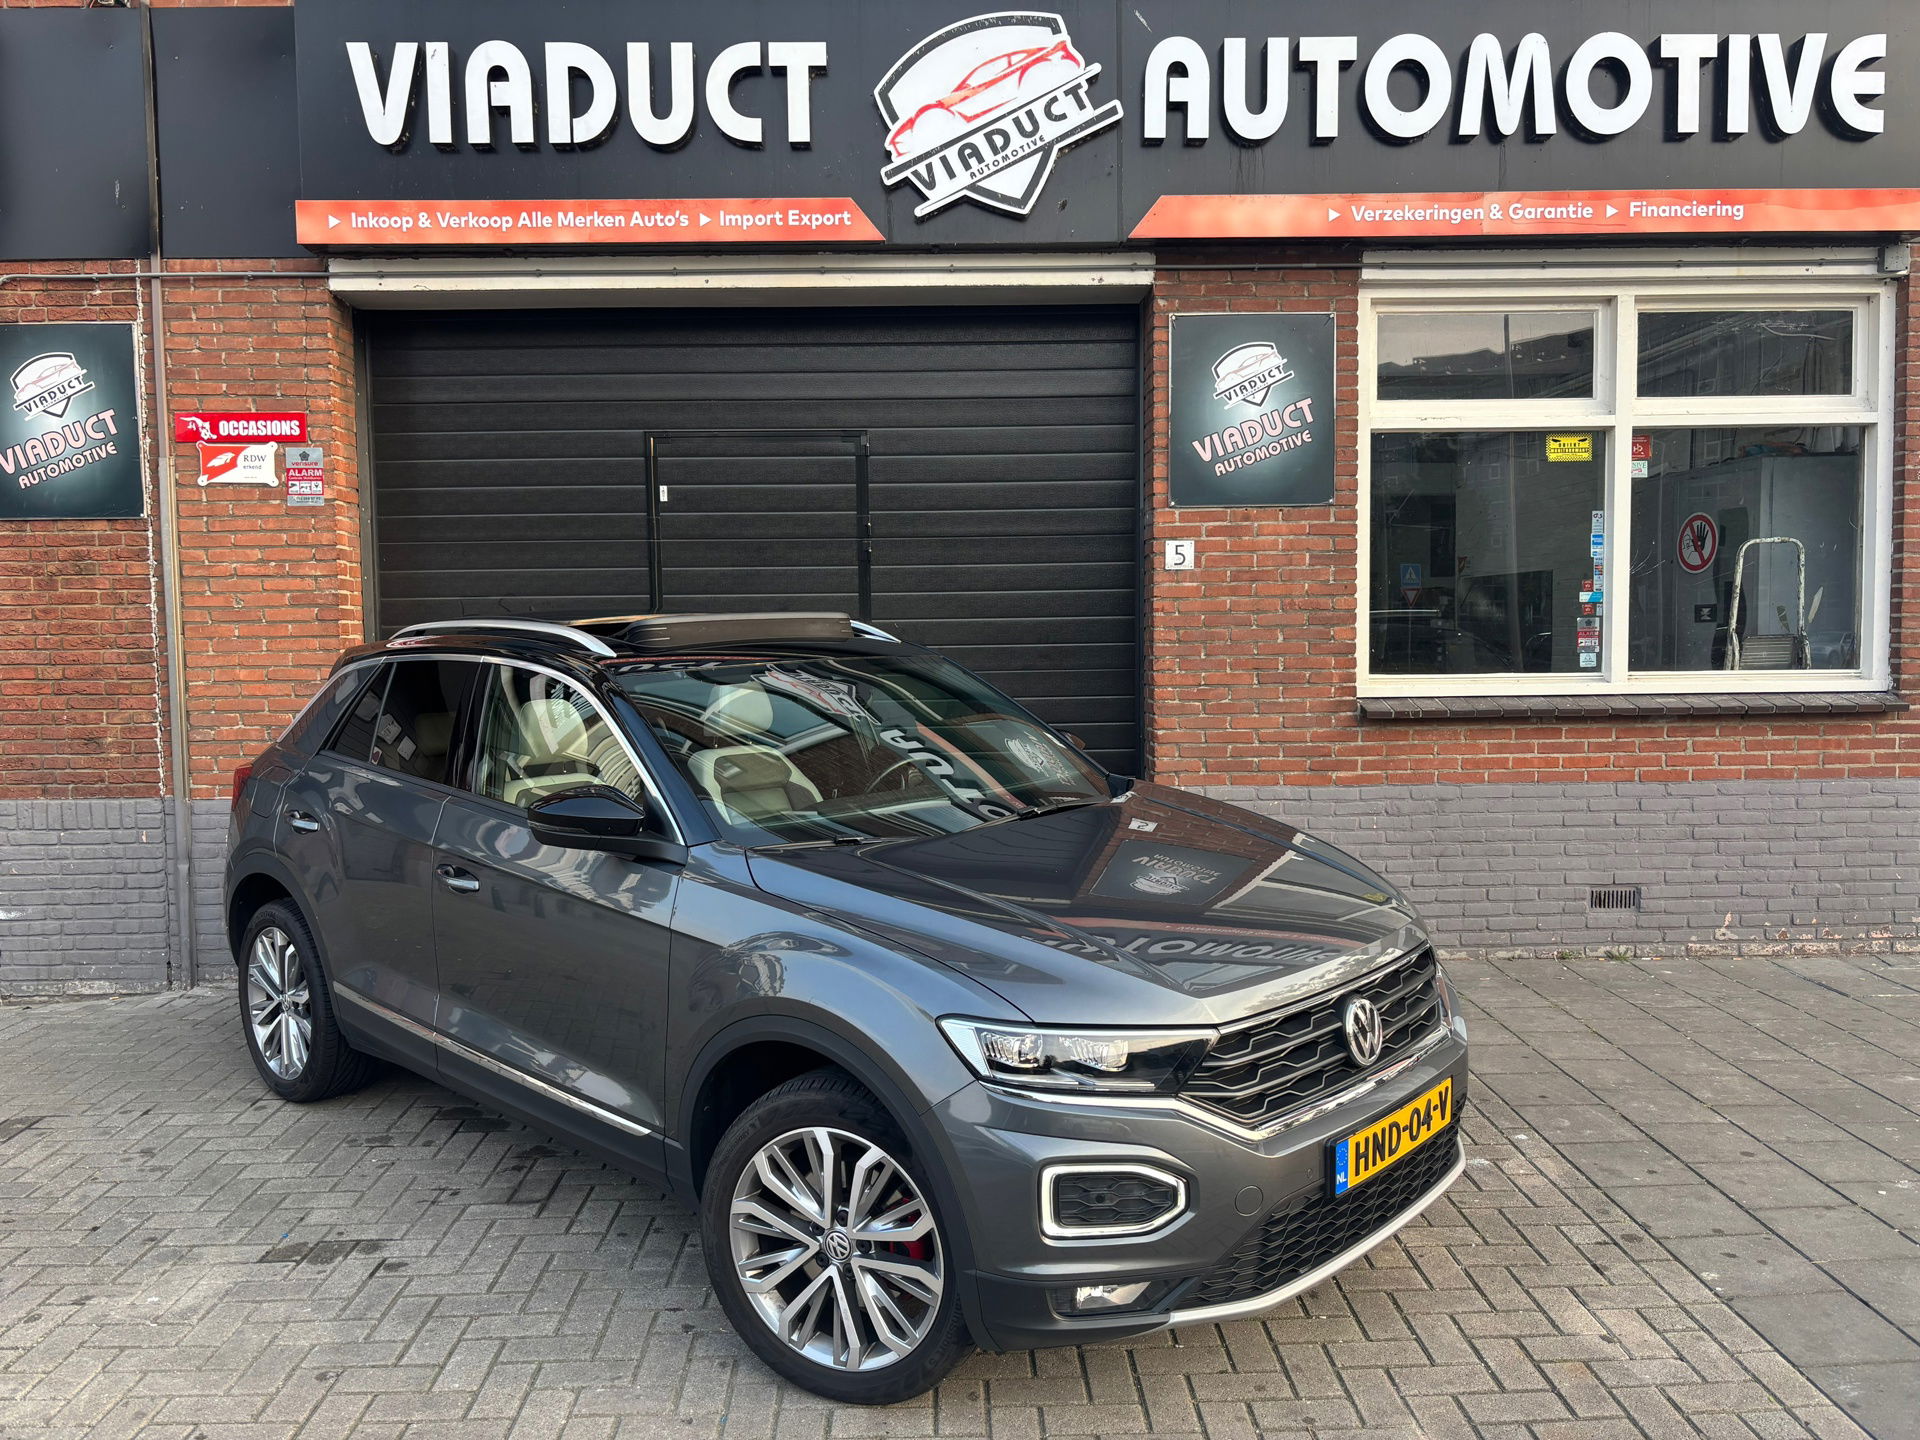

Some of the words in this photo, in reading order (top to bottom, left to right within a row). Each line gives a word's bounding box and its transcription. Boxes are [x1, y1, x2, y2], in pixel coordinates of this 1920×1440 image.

[345, 40, 827, 145] VIADUCT
[1143, 32, 1888, 141] AUTOMOTIVE
[910, 83, 1087, 191] VIADUCT
[969, 134, 1046, 180] AUTOMOTIVE
[351, 211, 414, 232] Inkoop
[418, 211, 432, 229] &
[436, 211, 513, 232] Verkoop
[517, 211, 552, 229] Alle
[557, 211, 626, 228] Merken
[629, 209, 689, 228] Auto's
[719, 209, 783, 230] Import
[788, 209, 852, 230] Export
[1351, 203, 1485, 225] Verzekeringen
[1489, 203, 1503, 220] &
[1508, 201, 1594, 220] Garantie
[1629, 200, 1745, 221] Financiering
[23, 375, 84, 413] VIADUCT
[1222, 364, 1284, 402] VIADUCT
[0, 409, 118, 475] VIADUCT
[218, 420, 301, 436] OCCASIONS
[1191, 397, 1315, 463] VIADUCT
[18, 441, 118, 490] AUTOMOTIVE
[243, 454, 267, 463] RDW
[288, 468, 323, 477] ALARM
[1213, 429, 1313, 478] AUTOMOTIVE
[1173, 544, 1187, 566] 5
[1354, 1085, 1450, 1178] HND-04-V
[1336, 1171, 1347, 1184] NL
